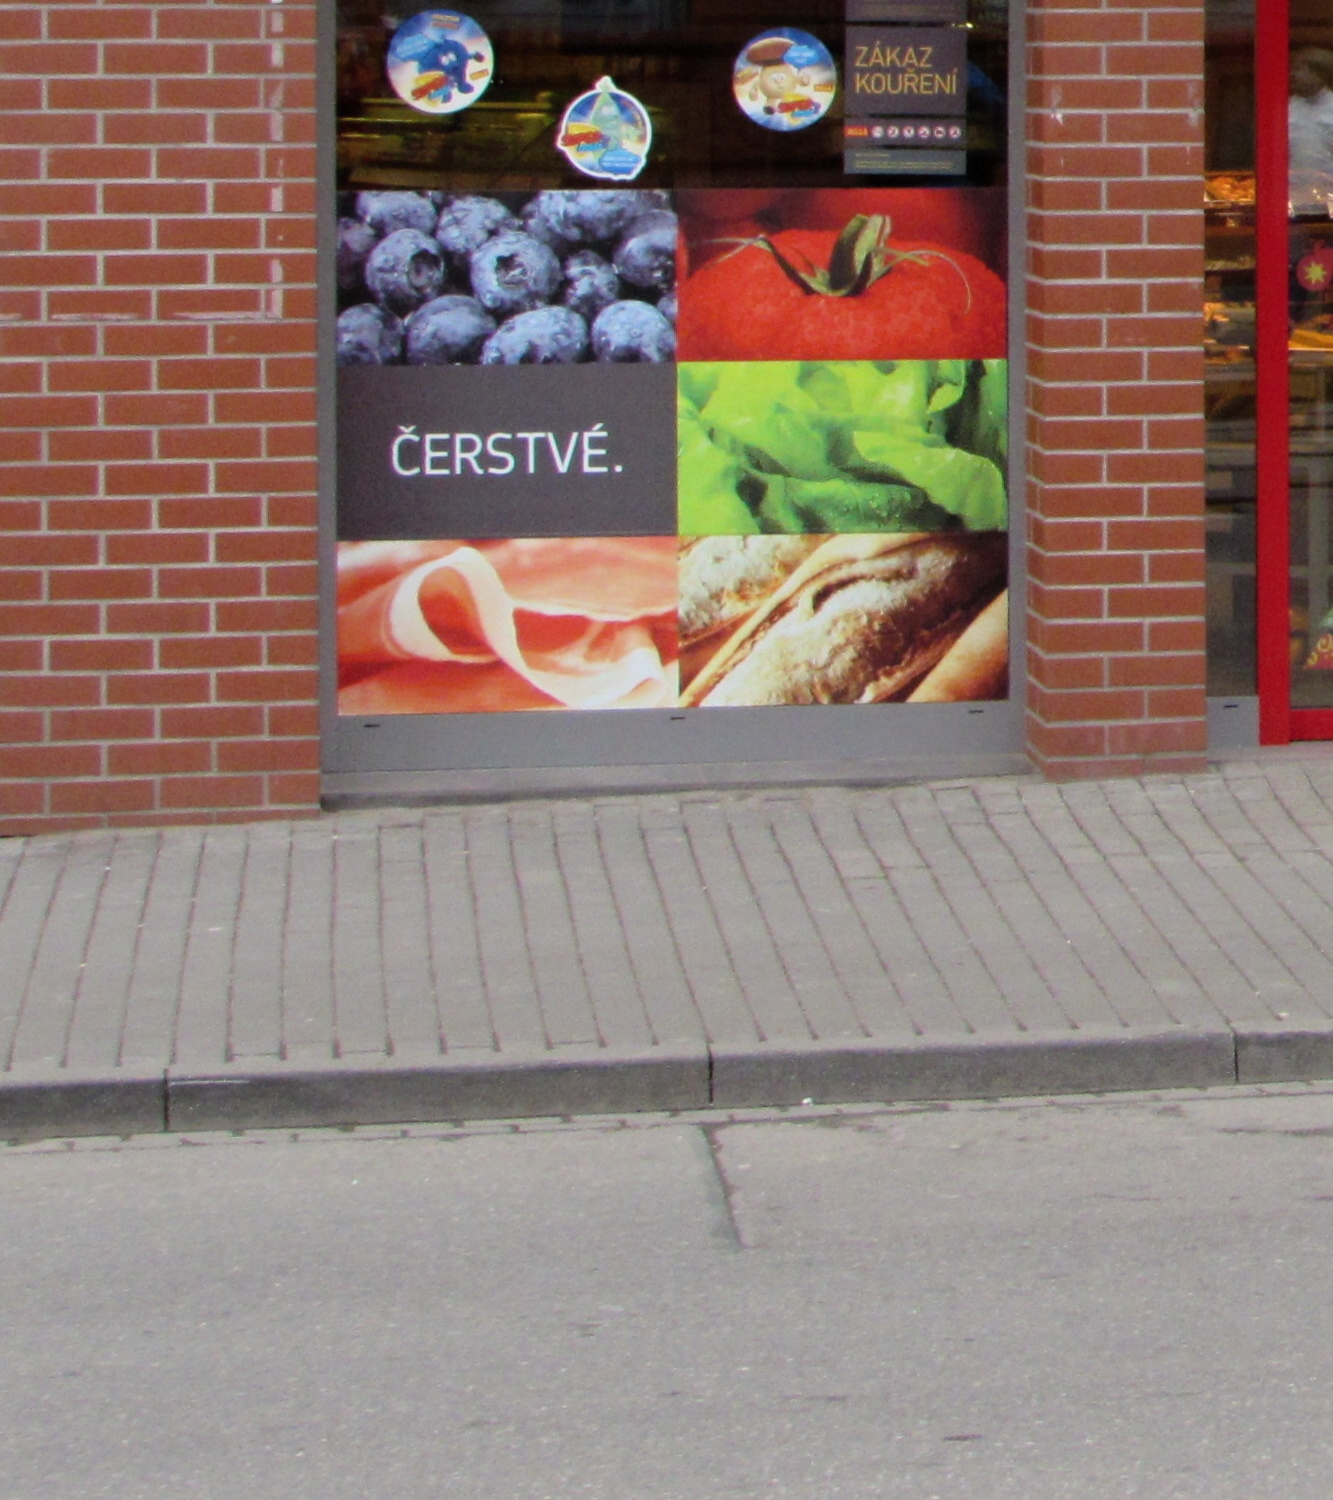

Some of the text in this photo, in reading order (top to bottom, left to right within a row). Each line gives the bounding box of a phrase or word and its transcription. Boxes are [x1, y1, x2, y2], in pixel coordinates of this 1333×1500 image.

[855, 41, 933, 68] ZÁKAZ
[855, 68, 958, 94] KOUŘENÍ
[390, 422, 624, 476] ČERSTVÉ.
